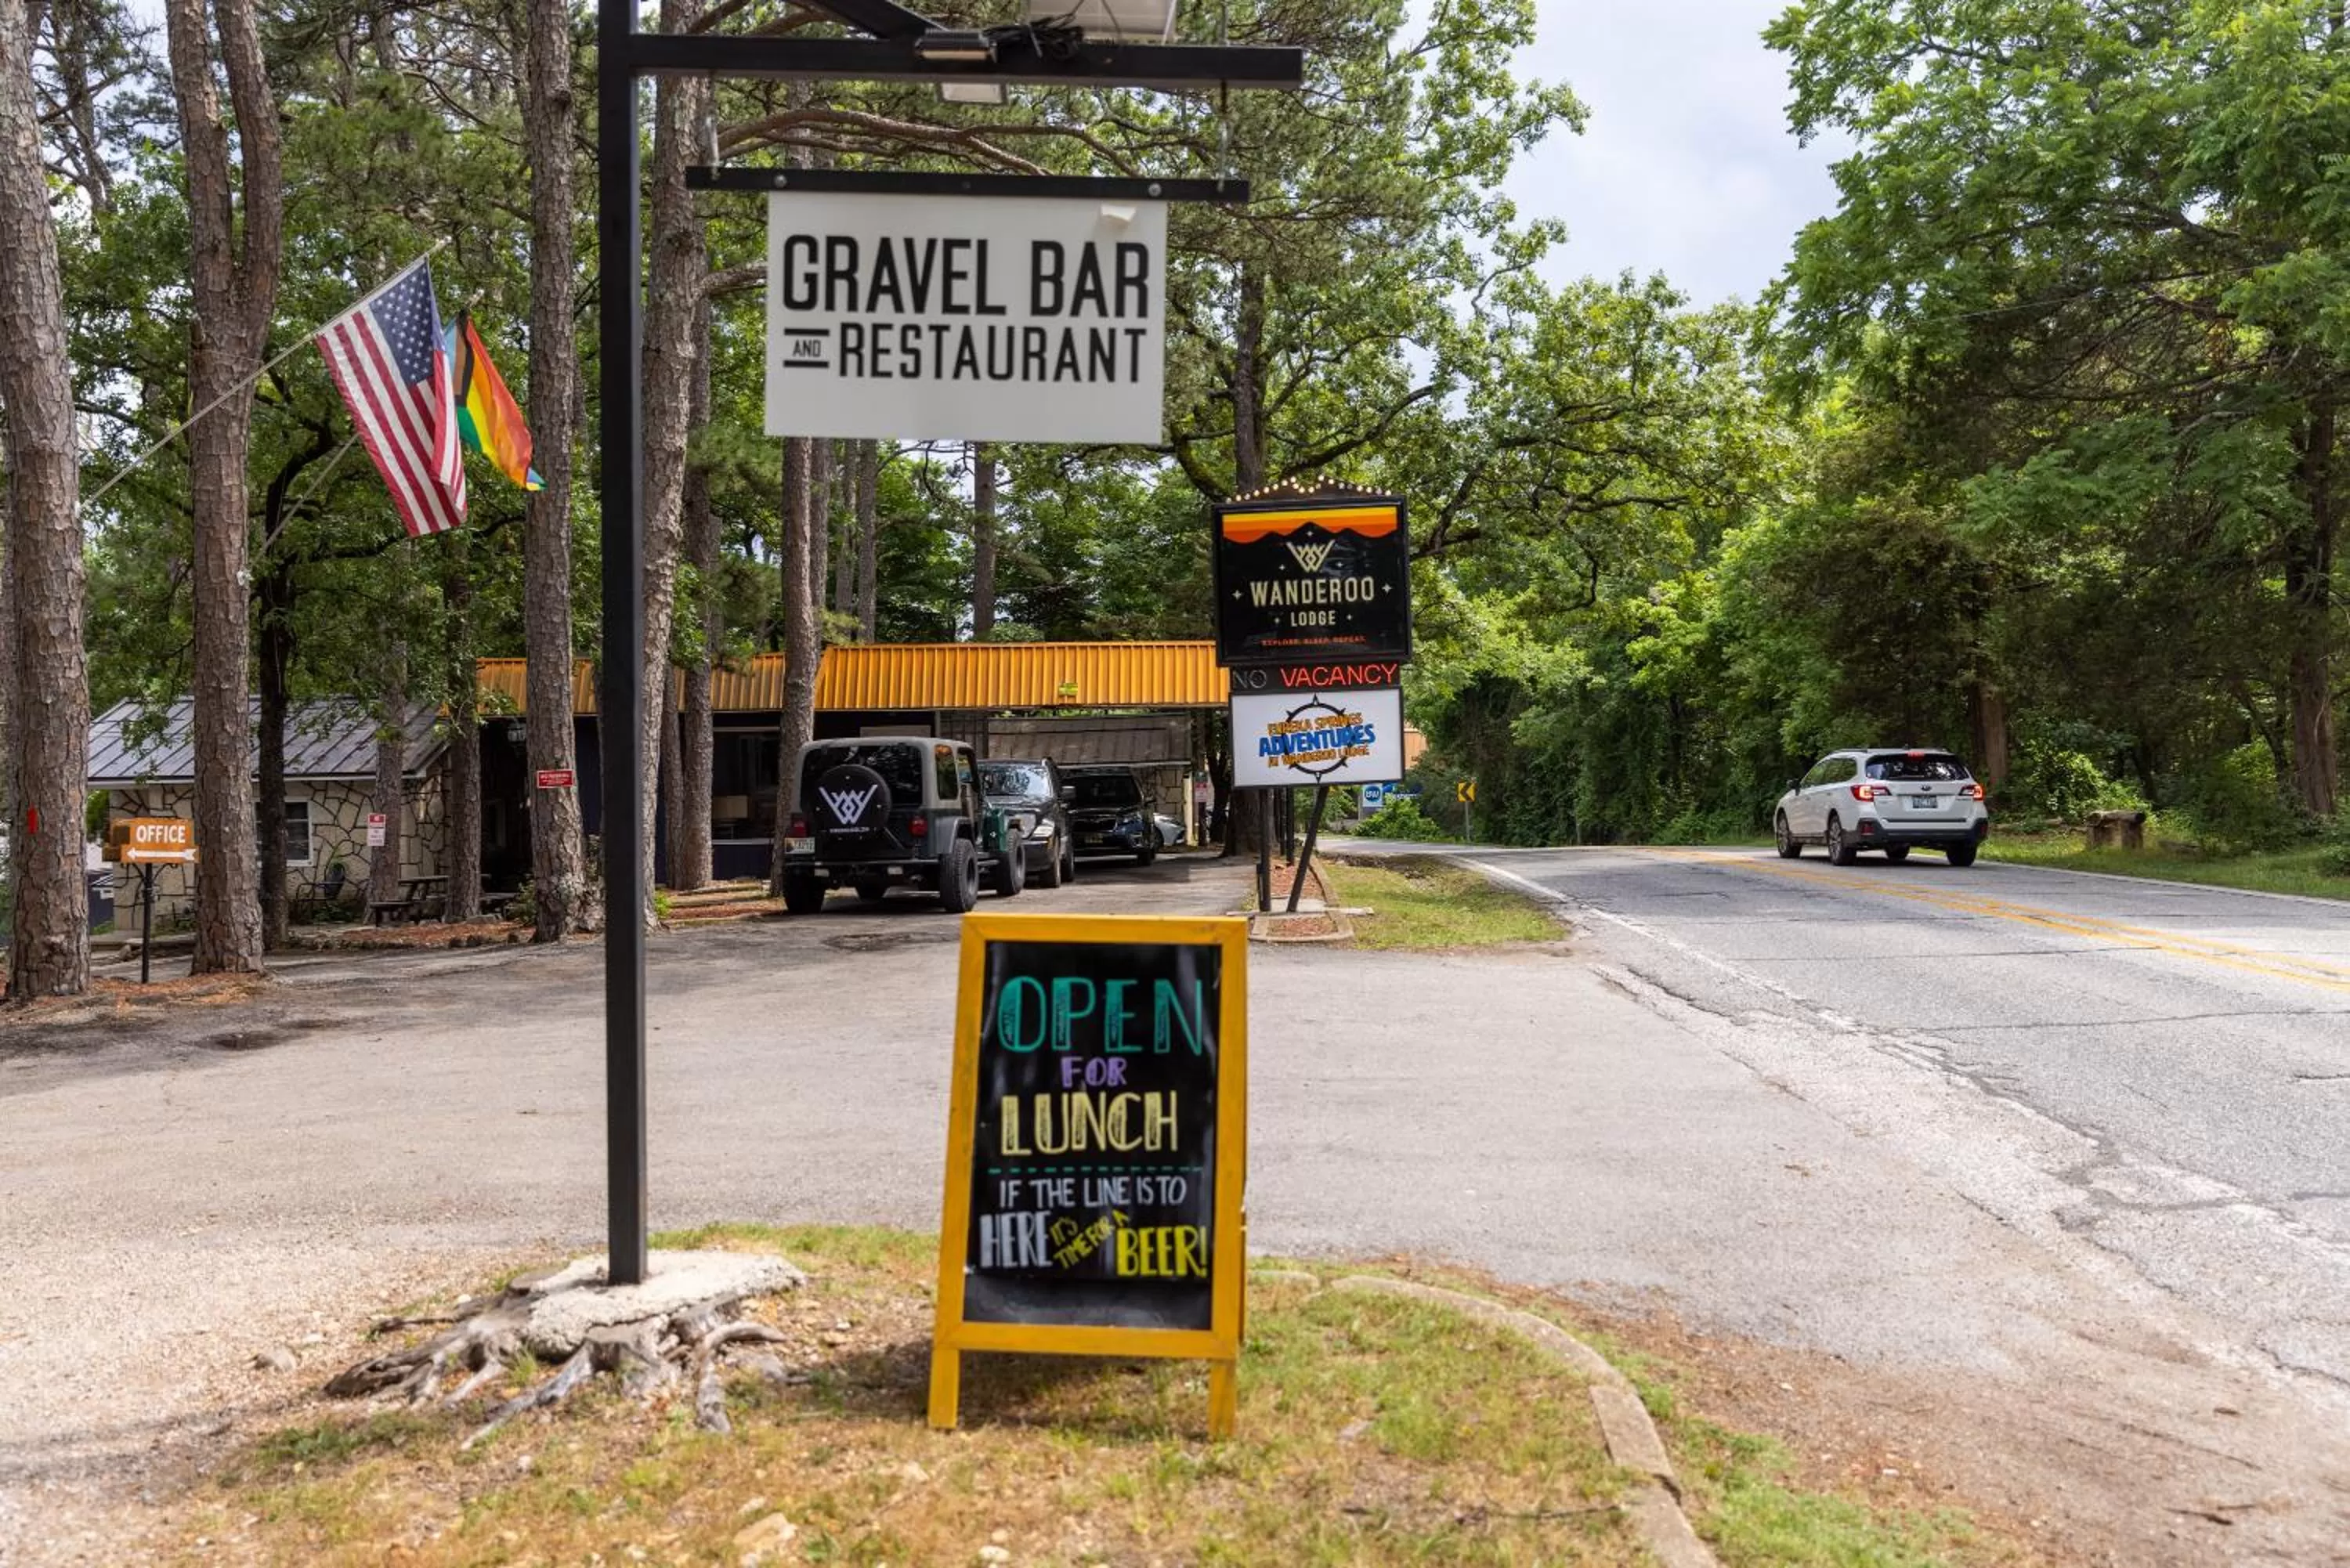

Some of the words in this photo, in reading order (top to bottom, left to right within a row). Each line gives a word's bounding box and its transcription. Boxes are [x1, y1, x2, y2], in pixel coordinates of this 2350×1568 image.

[783, 234, 1007, 316] GRAVEL
[1030, 240, 1149, 319] BAR
[793, 339, 821, 358] AND
[840, 322, 1147, 383] RESTAURANT
[1250, 576, 1375, 608] WANDEROO
[1290, 610, 1336, 627] LODGE
[1232, 669, 1267, 689] NO
[1280, 663, 1398, 688] VACANCY
[1259, 724, 1376, 757] ADVENTURES
[136, 825, 186, 844] OFFICE
[997, 976, 1202, 1056] OPEN
[1061, 1057, 1127, 1088] FOR
[1001, 1090, 1177, 1155] LUNCH
[1000, 1179, 1021, 1209] IF
[1029, 1177, 1076, 1209] THE
[1084, 1176, 1130, 1207] LINE
[1137, 1176, 1153, 1205] IS
[1155, 1176, 1187, 1205] TO
[980, 1210, 1053, 1268] HERE
[1053, 1233, 1093, 1269] TIME
[1085, 1216, 1115, 1247] FOR
[1112, 1209, 1130, 1227] A
[1117, 1224, 1208, 1278] BEER!
